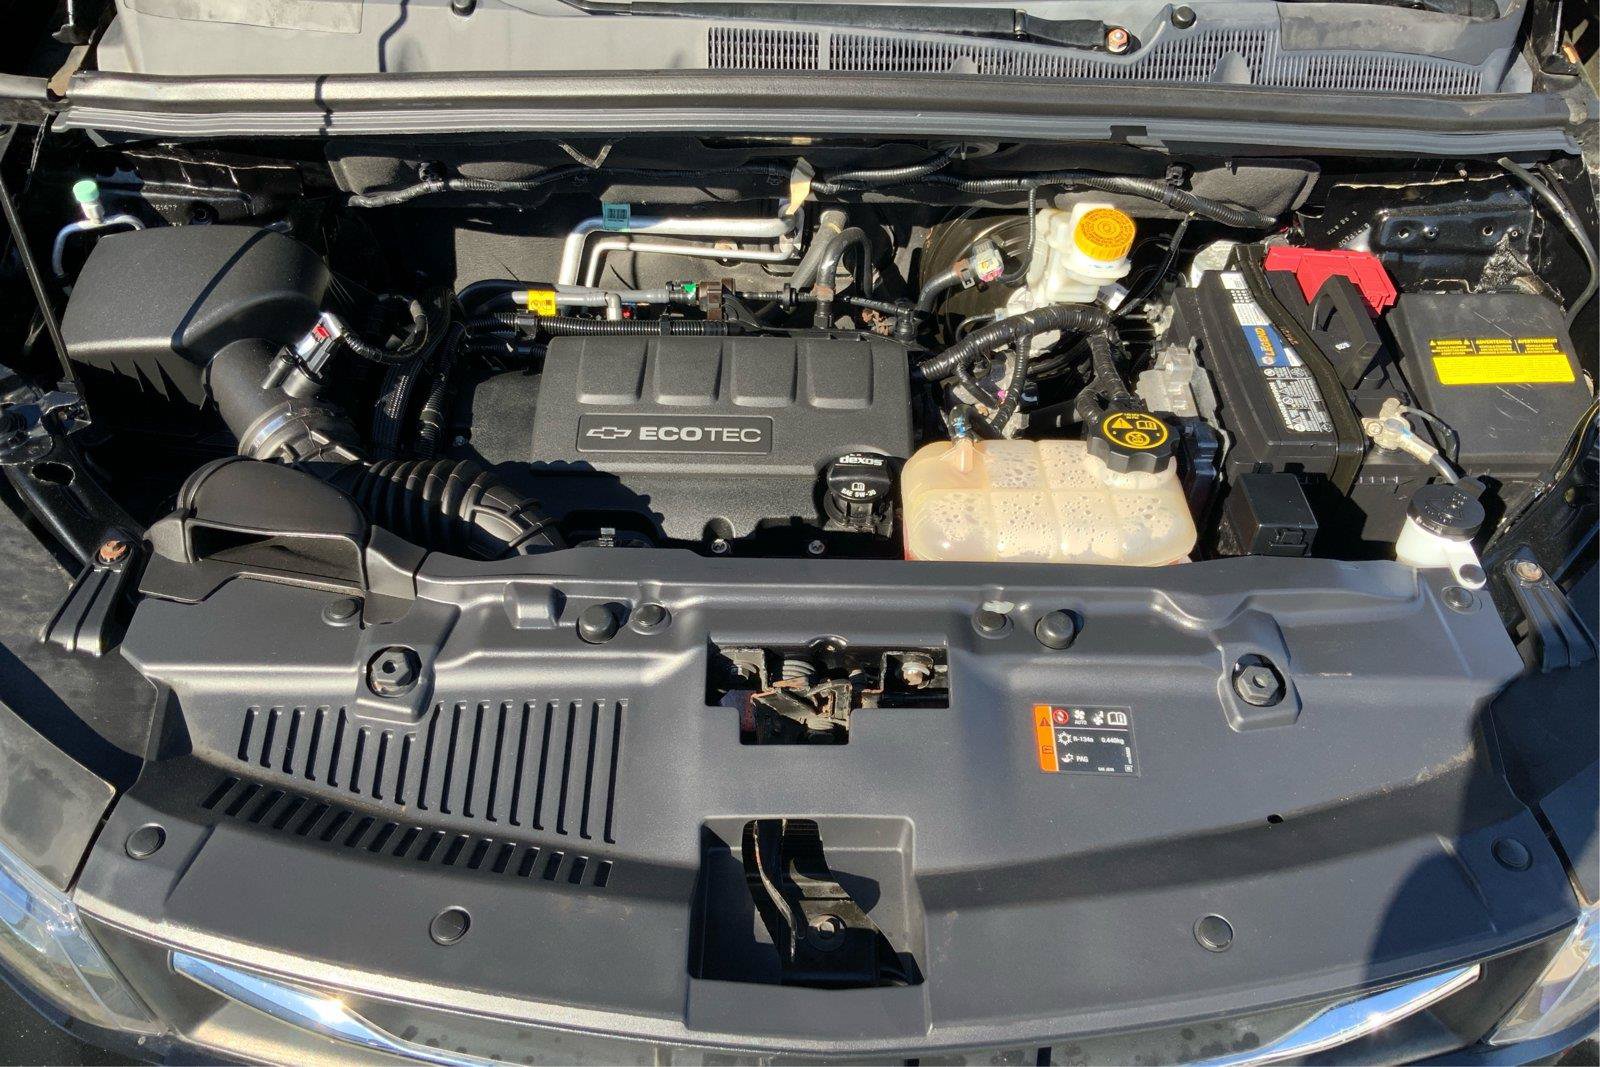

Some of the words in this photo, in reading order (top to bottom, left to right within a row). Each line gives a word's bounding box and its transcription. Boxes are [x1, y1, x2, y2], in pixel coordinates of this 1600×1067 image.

[639, 426, 762, 443] ECOTEC
[839, 455, 884, 466] dexos
[841, 487, 853, 497] SAE
[1076, 755, 1089, 763] PAG
